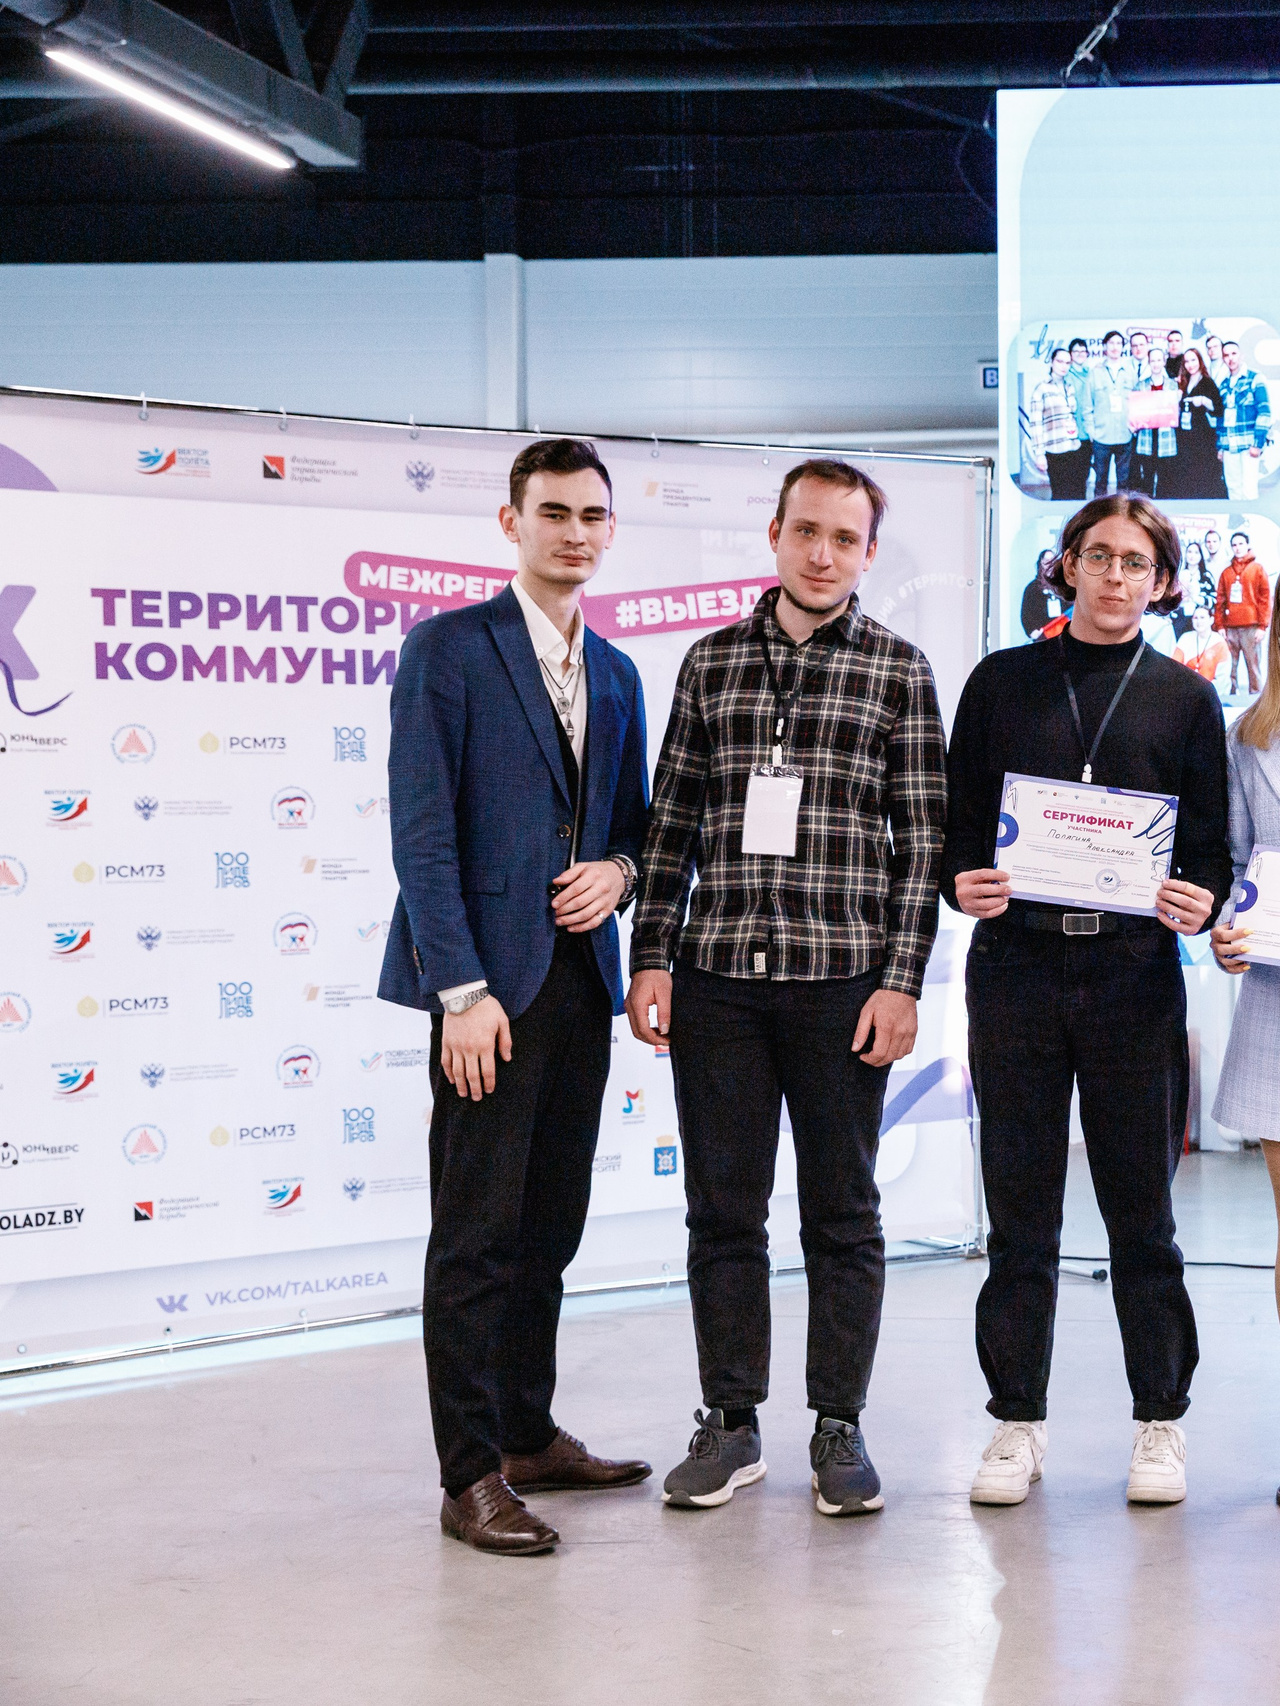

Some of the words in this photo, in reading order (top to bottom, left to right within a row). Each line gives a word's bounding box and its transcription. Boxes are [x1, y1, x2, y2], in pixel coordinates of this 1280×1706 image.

[359, 562, 512, 602] МЕЖРЕГ
[91, 588, 440, 635] ТЕРРИТОРИ
[95, 642, 398, 685] КОММУНИ
[229, 736, 287, 750] РСМ73
[1043, 809, 1134, 830] СЕРТИФИКАТ
[1067, 825, 1102, 834] УЧАСТНИКА
[105, 864, 166, 879] РСМ73
[109, 997, 169, 1012] РСМ73
[239, 1124, 296, 1140] РСМ73
[0, 1208, 85, 1230] OLADZ.BY
[205, 1271, 389, 1307] VK.COM/TALKAREA
